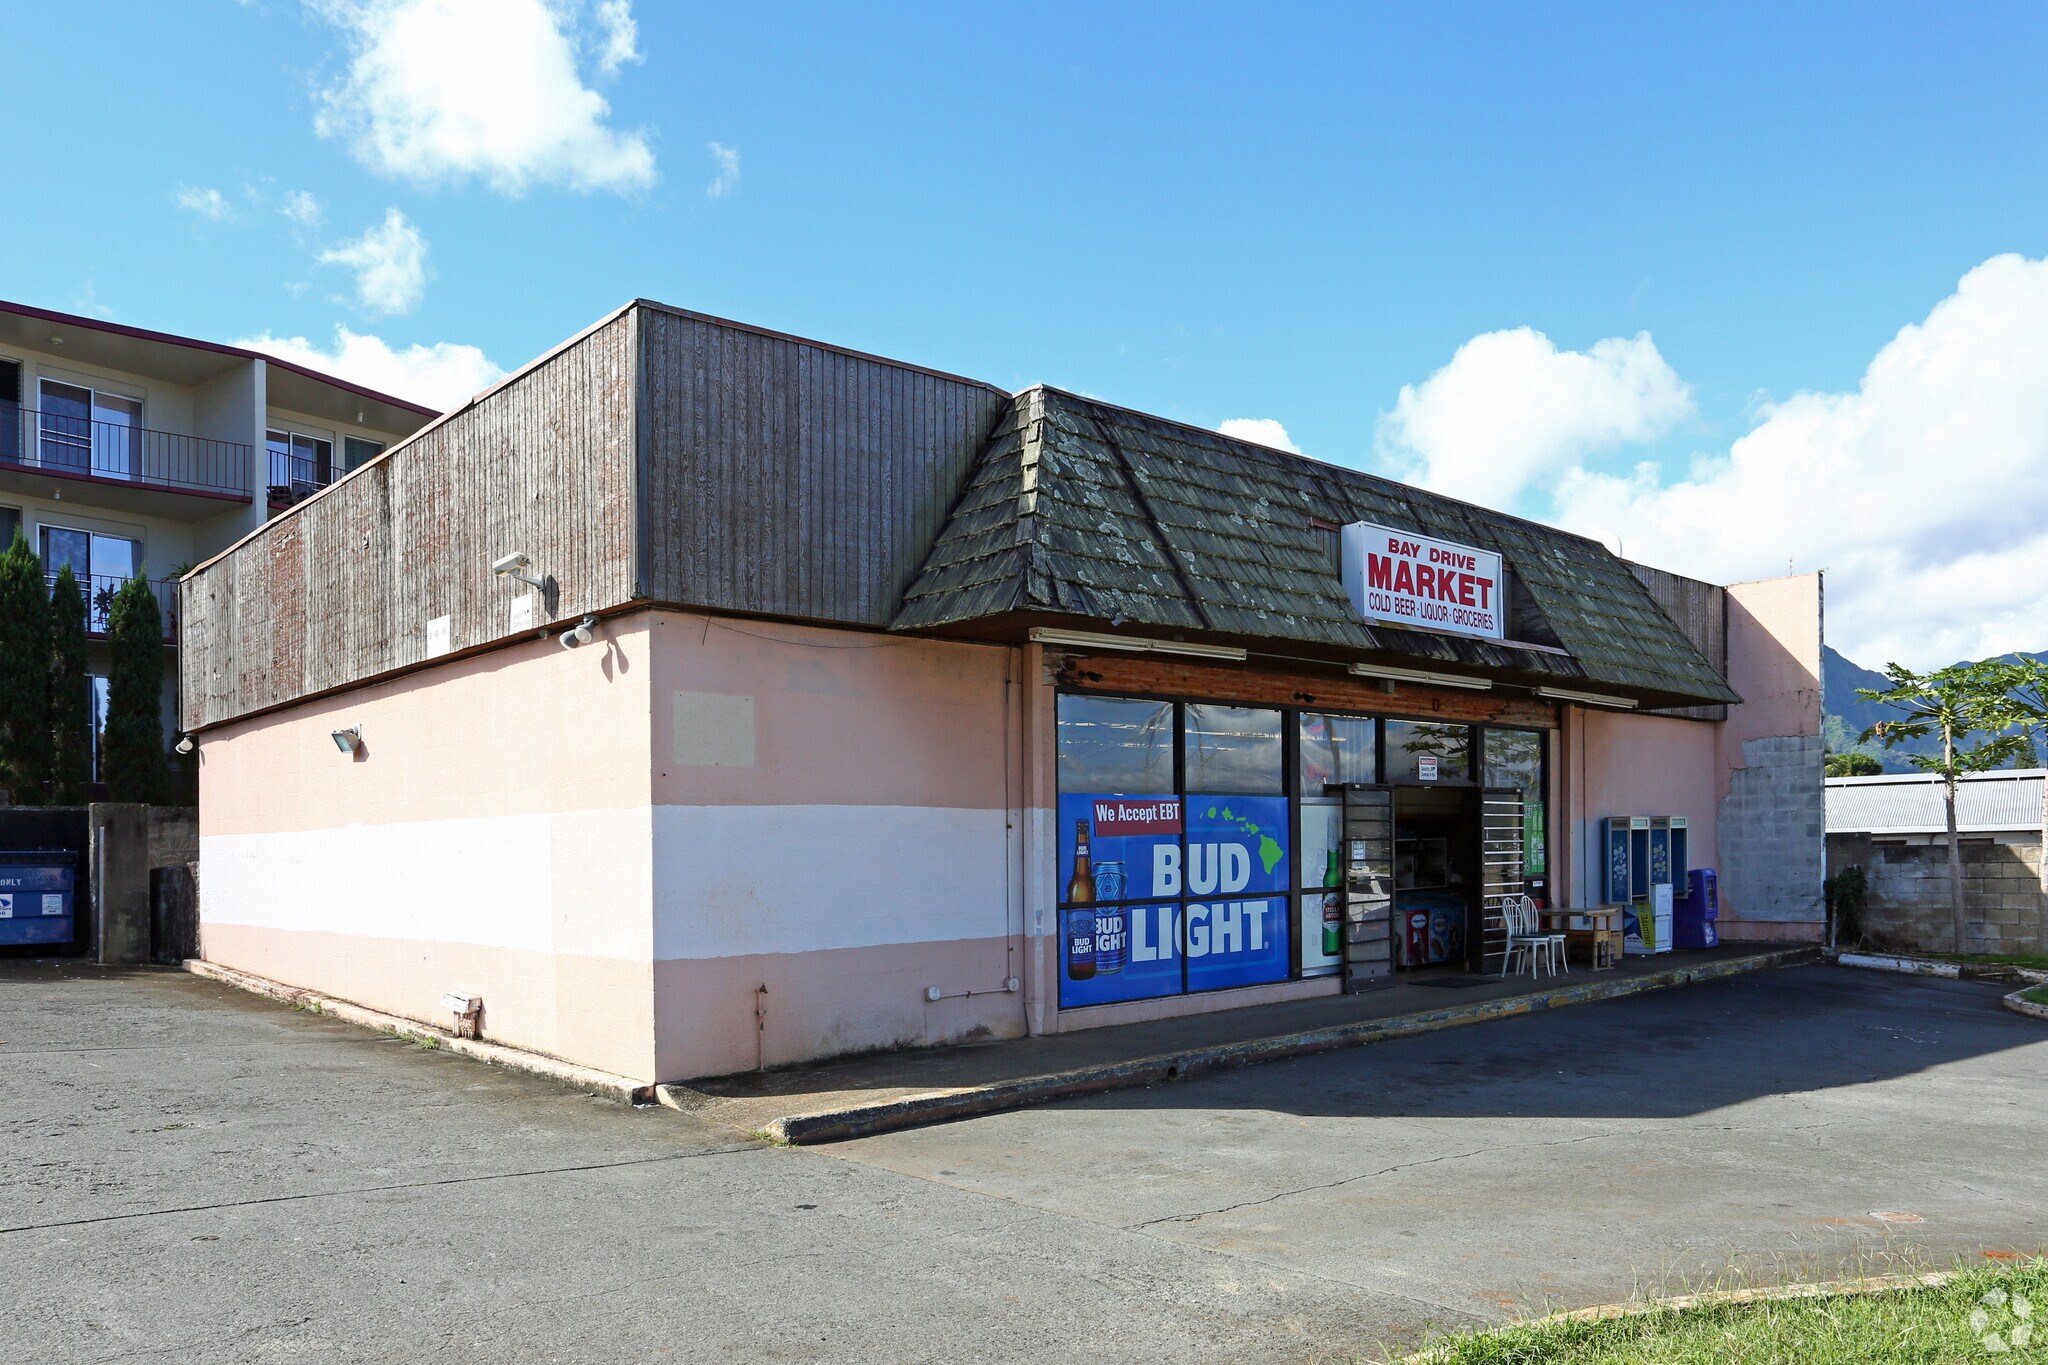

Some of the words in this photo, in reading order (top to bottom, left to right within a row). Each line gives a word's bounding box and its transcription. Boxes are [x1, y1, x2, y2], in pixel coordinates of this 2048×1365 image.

[1388, 537, 1422, 558] BAY
[1429, 547, 1476, 571] DRIVE
[1367, 552, 1493, 610] MARKET
[1368, 592, 1391, 613] COLD
[1394, 597, 1416, 617] BEER
[1420, 602, 1448, 622] LIQUOR
[1453, 608, 1494, 630] GROCERIES
[1095, 804, 1115, 822] We
[1118, 805, 1158, 826] Accept
[1159, 803, 1180, 820] EBT
[1152, 842, 1251, 897] BUD
[0, 878, 22, 886] ONLY
[1095, 916, 1123, 935] BUD
[1131, 900, 1269, 963] LIGHT
[1071, 945, 1093, 955] LIGHT
[1074, 937, 1090, 946] BUD
[1095, 931, 1127, 952] IGHT
